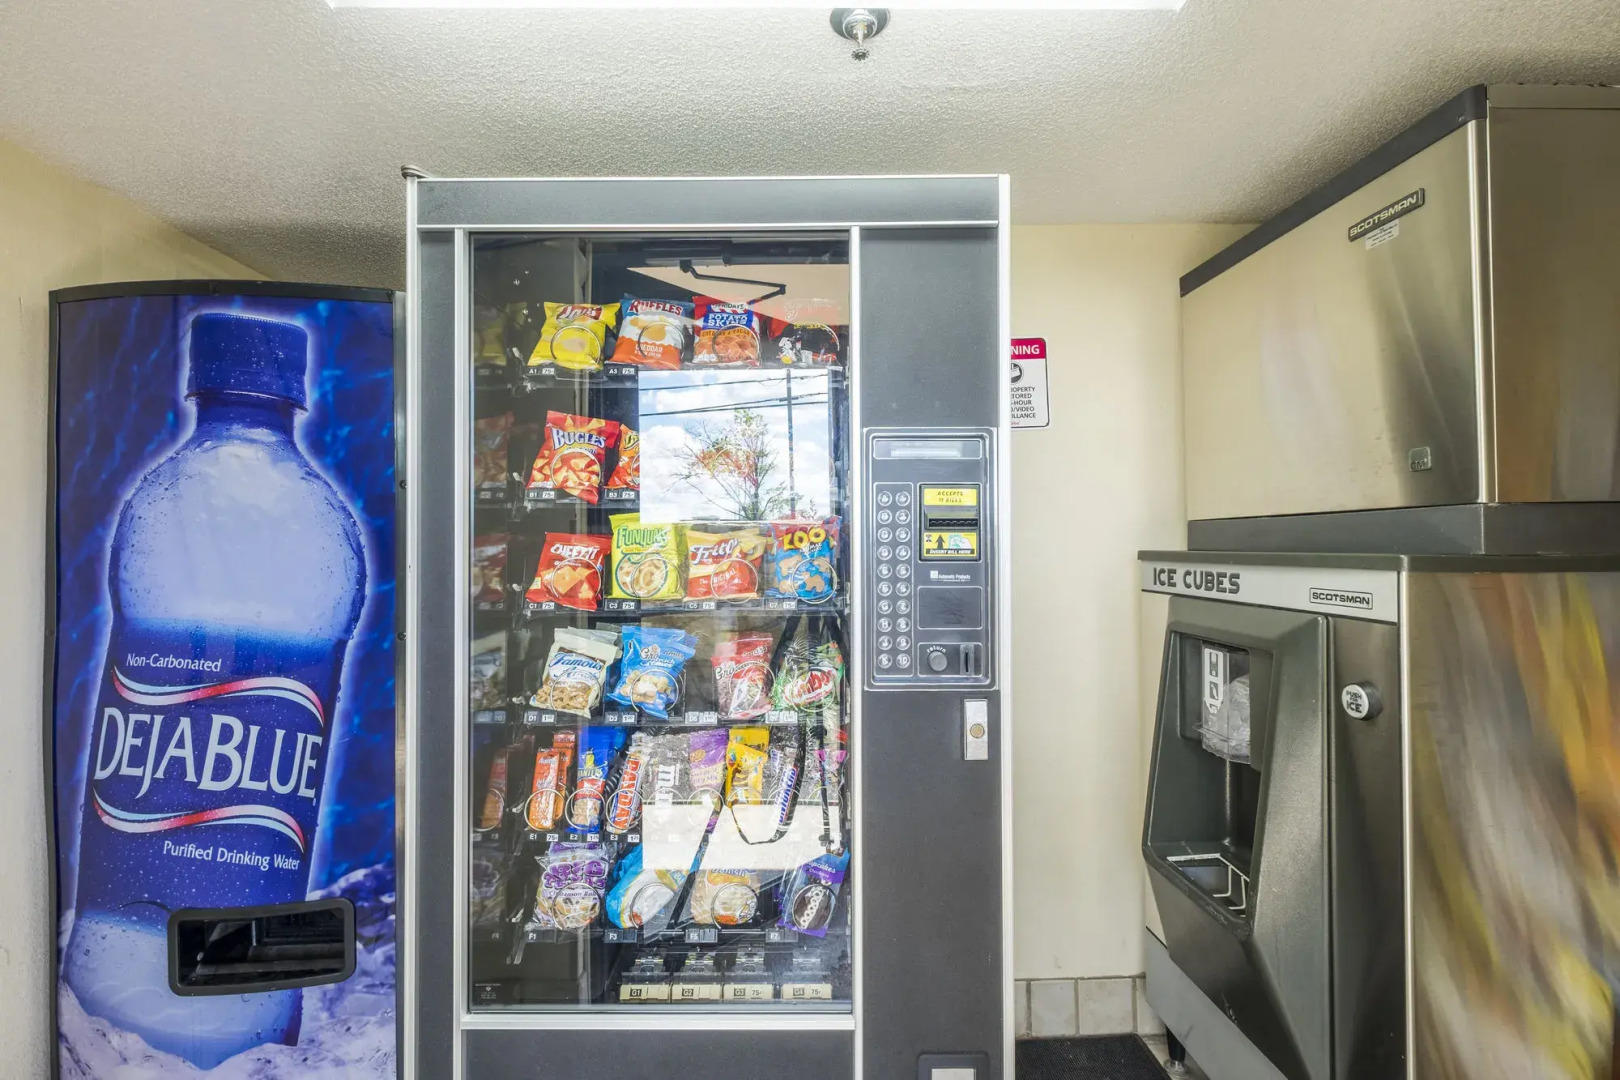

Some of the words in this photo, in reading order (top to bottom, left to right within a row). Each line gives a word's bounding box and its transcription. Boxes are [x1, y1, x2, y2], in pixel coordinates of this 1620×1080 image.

[1350, 195, 1417, 237] SCOTSMAN
[627, 299, 683, 316] RUFFLES
[551, 427, 605, 450] BUGLES
[616, 525, 669, 549] FUNYUNS
[783, 526, 827, 551] ZOO
[689, 538, 738, 565] Frito
[1153, 567, 1177, 588] ICE
[1183, 570, 1241, 594] CUBES
[1312, 592, 1370, 606] SCOTSMAN
[126, 653, 222, 672] Non-Carbonated
[549, 652, 603, 671] Famous
[1346, 690, 1362, 700] PUSH
[1346, 700, 1362, 713] ICE
[163, 840, 213, 861] Purified
[217, 847, 270, 871] Drinking
[273, 854, 300, 870] Water
[807, 861, 837, 873] upcakes
